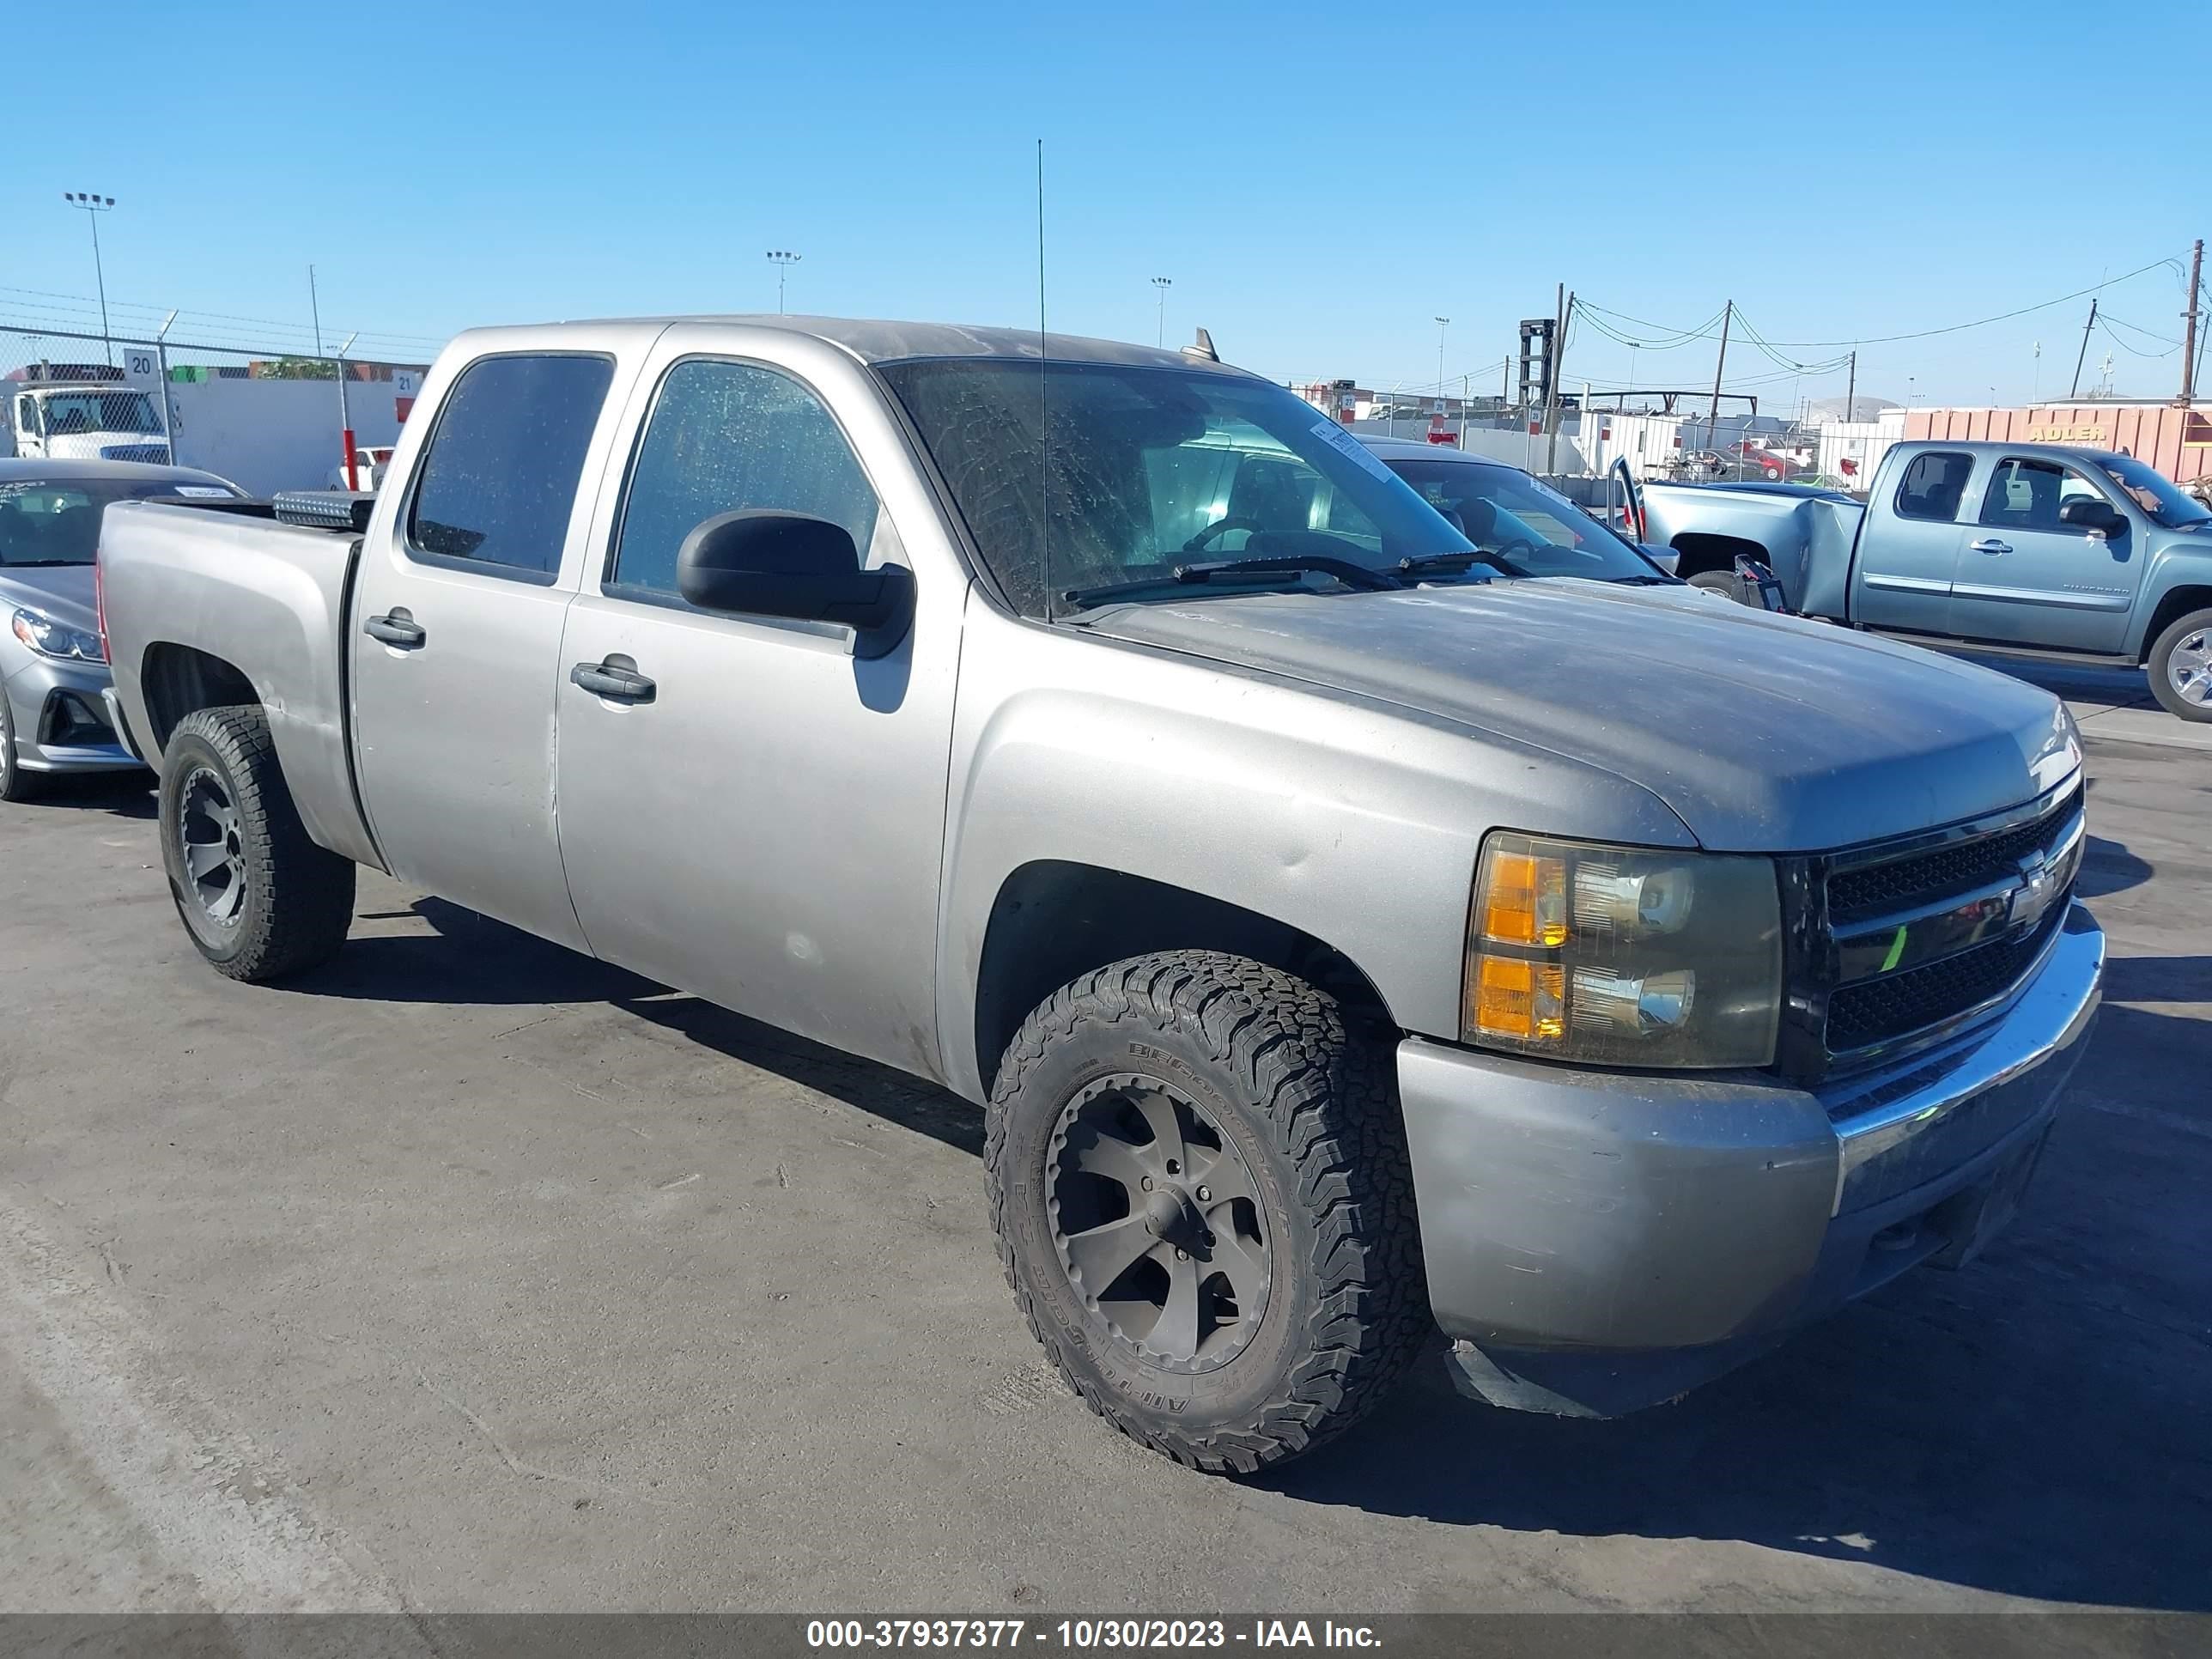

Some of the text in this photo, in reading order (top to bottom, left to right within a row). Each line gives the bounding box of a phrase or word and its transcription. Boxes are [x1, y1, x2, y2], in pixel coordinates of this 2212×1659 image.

[132, 356, 151, 374] 20
[398, 376, 411, 391] 21
[1345, 398, 1353, 406] 27
[2029, 426, 2107, 441] ADLER
